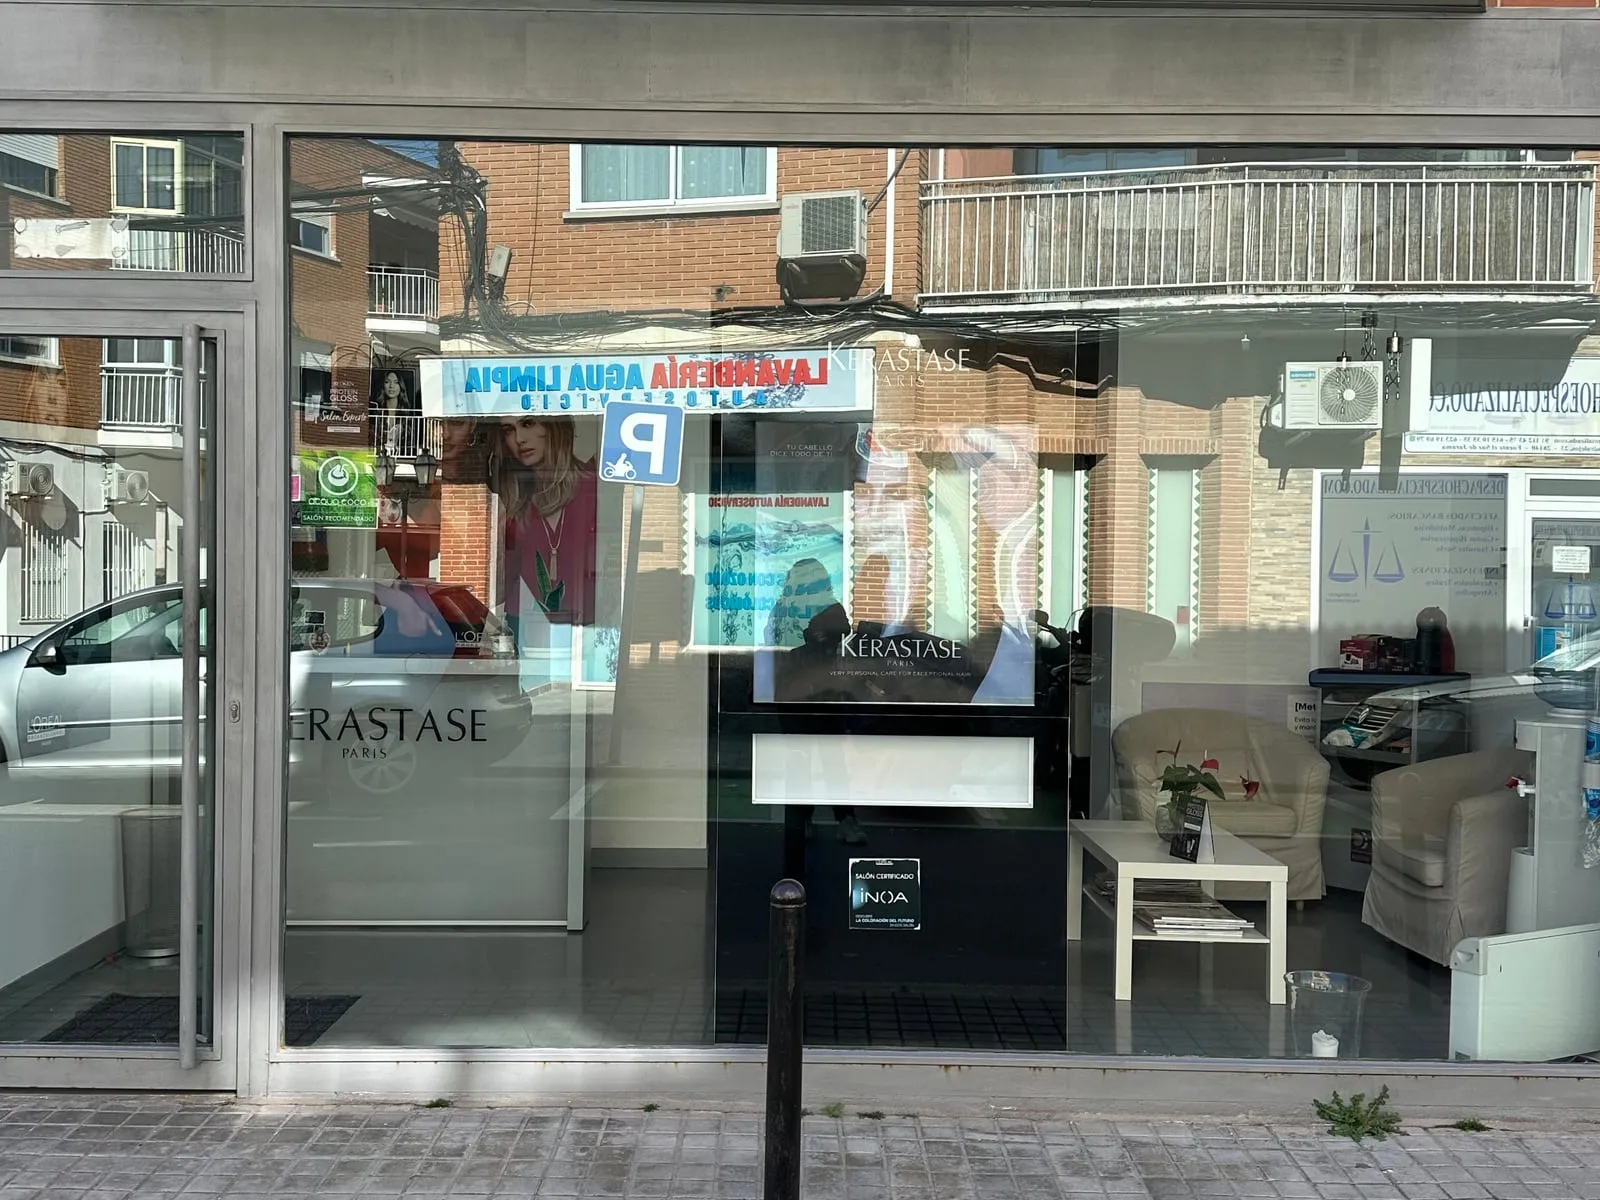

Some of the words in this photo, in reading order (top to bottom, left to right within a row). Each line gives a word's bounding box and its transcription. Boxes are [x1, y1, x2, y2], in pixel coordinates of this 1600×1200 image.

[329, 394, 359, 402] GLOSS
[840, 632, 962, 659] KÉRASTASE
[886, 659, 915, 667] PARIS
[342, 747, 387, 759] PARIS
[855, 872, 875, 880] SALÓN
